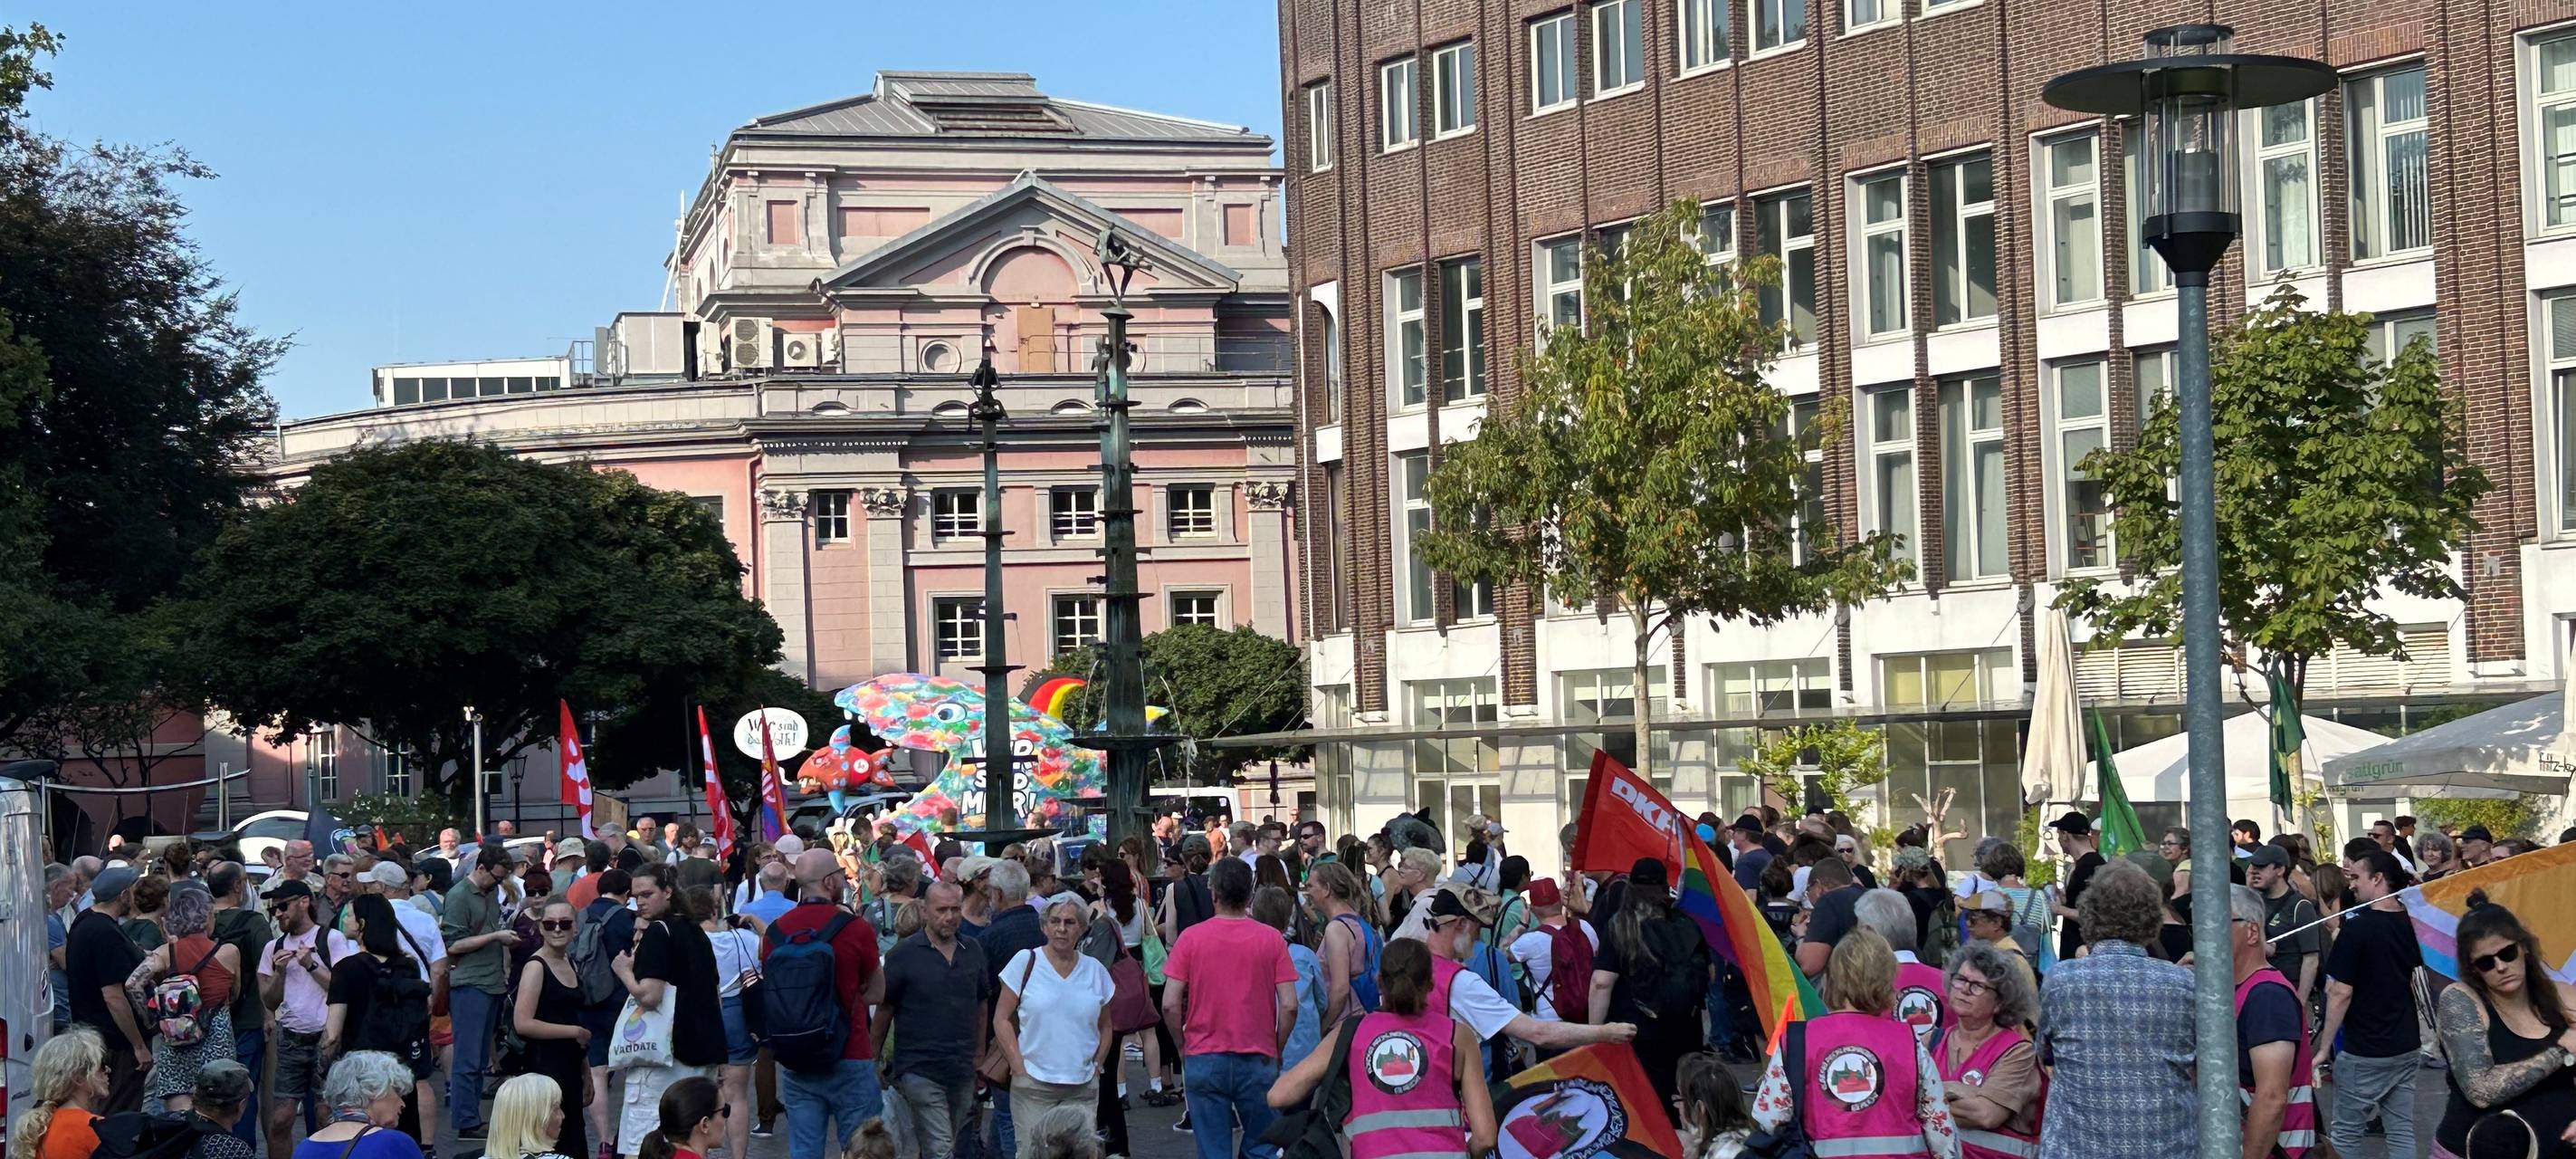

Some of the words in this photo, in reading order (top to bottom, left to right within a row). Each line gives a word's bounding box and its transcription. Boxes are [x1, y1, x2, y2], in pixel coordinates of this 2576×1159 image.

[778, 719, 798, 731] sind
[973, 769, 1028, 790] SD
[960, 790, 1037, 819] MR!
